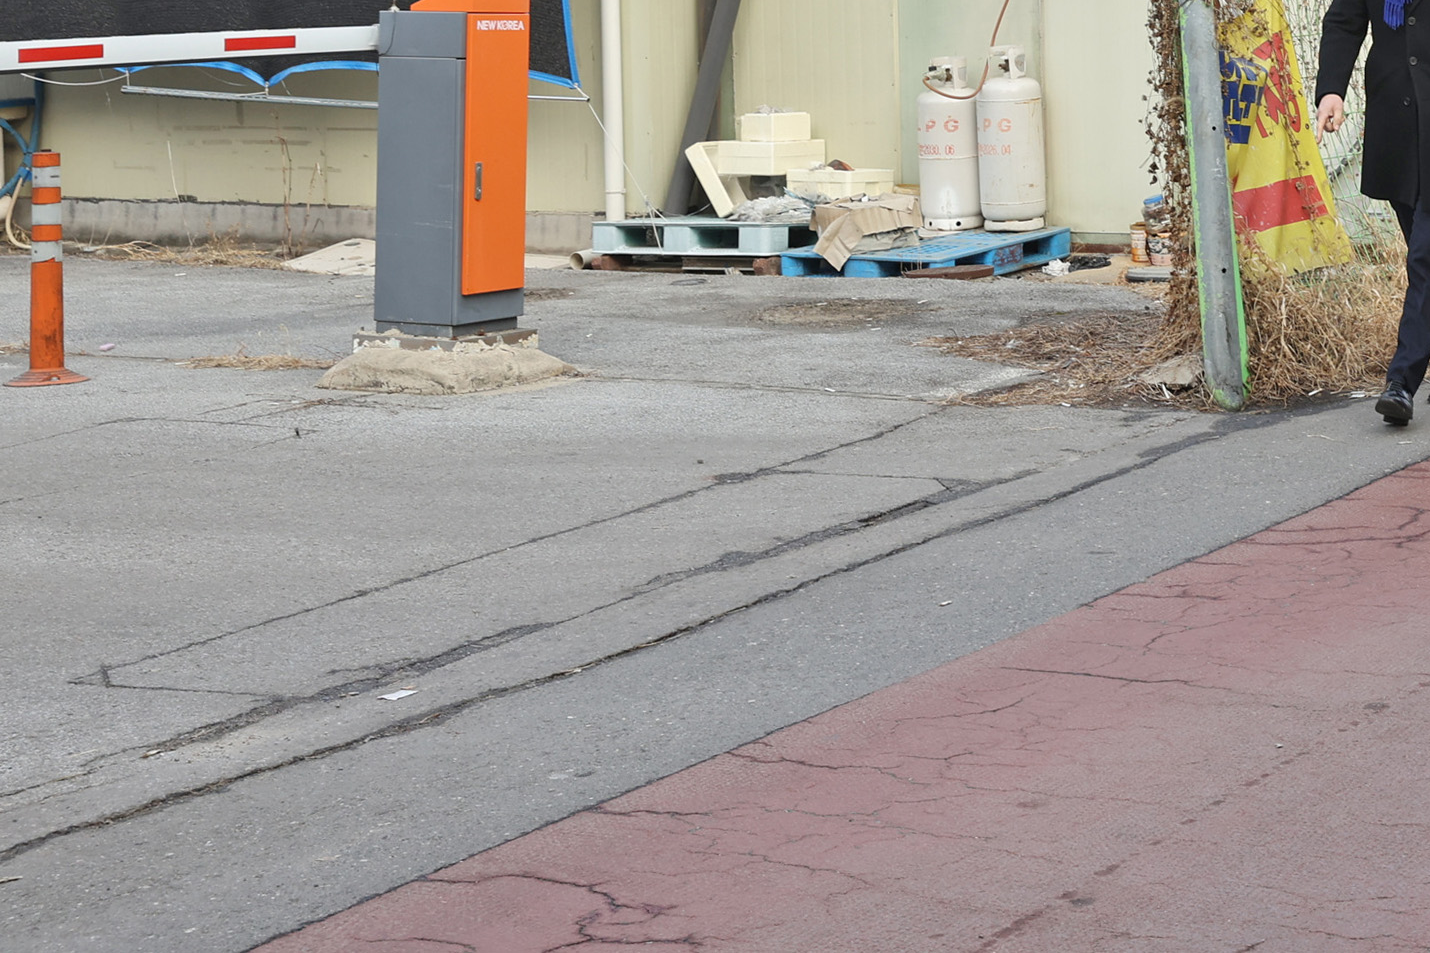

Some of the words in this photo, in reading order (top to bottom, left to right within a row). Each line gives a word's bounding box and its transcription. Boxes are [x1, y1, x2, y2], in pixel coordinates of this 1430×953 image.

[476, 20, 498, 30] NEW
[497, 20, 525, 30] KOREA
[917, 118, 959, 133] PG
[977, 117, 1012, 132] PG
